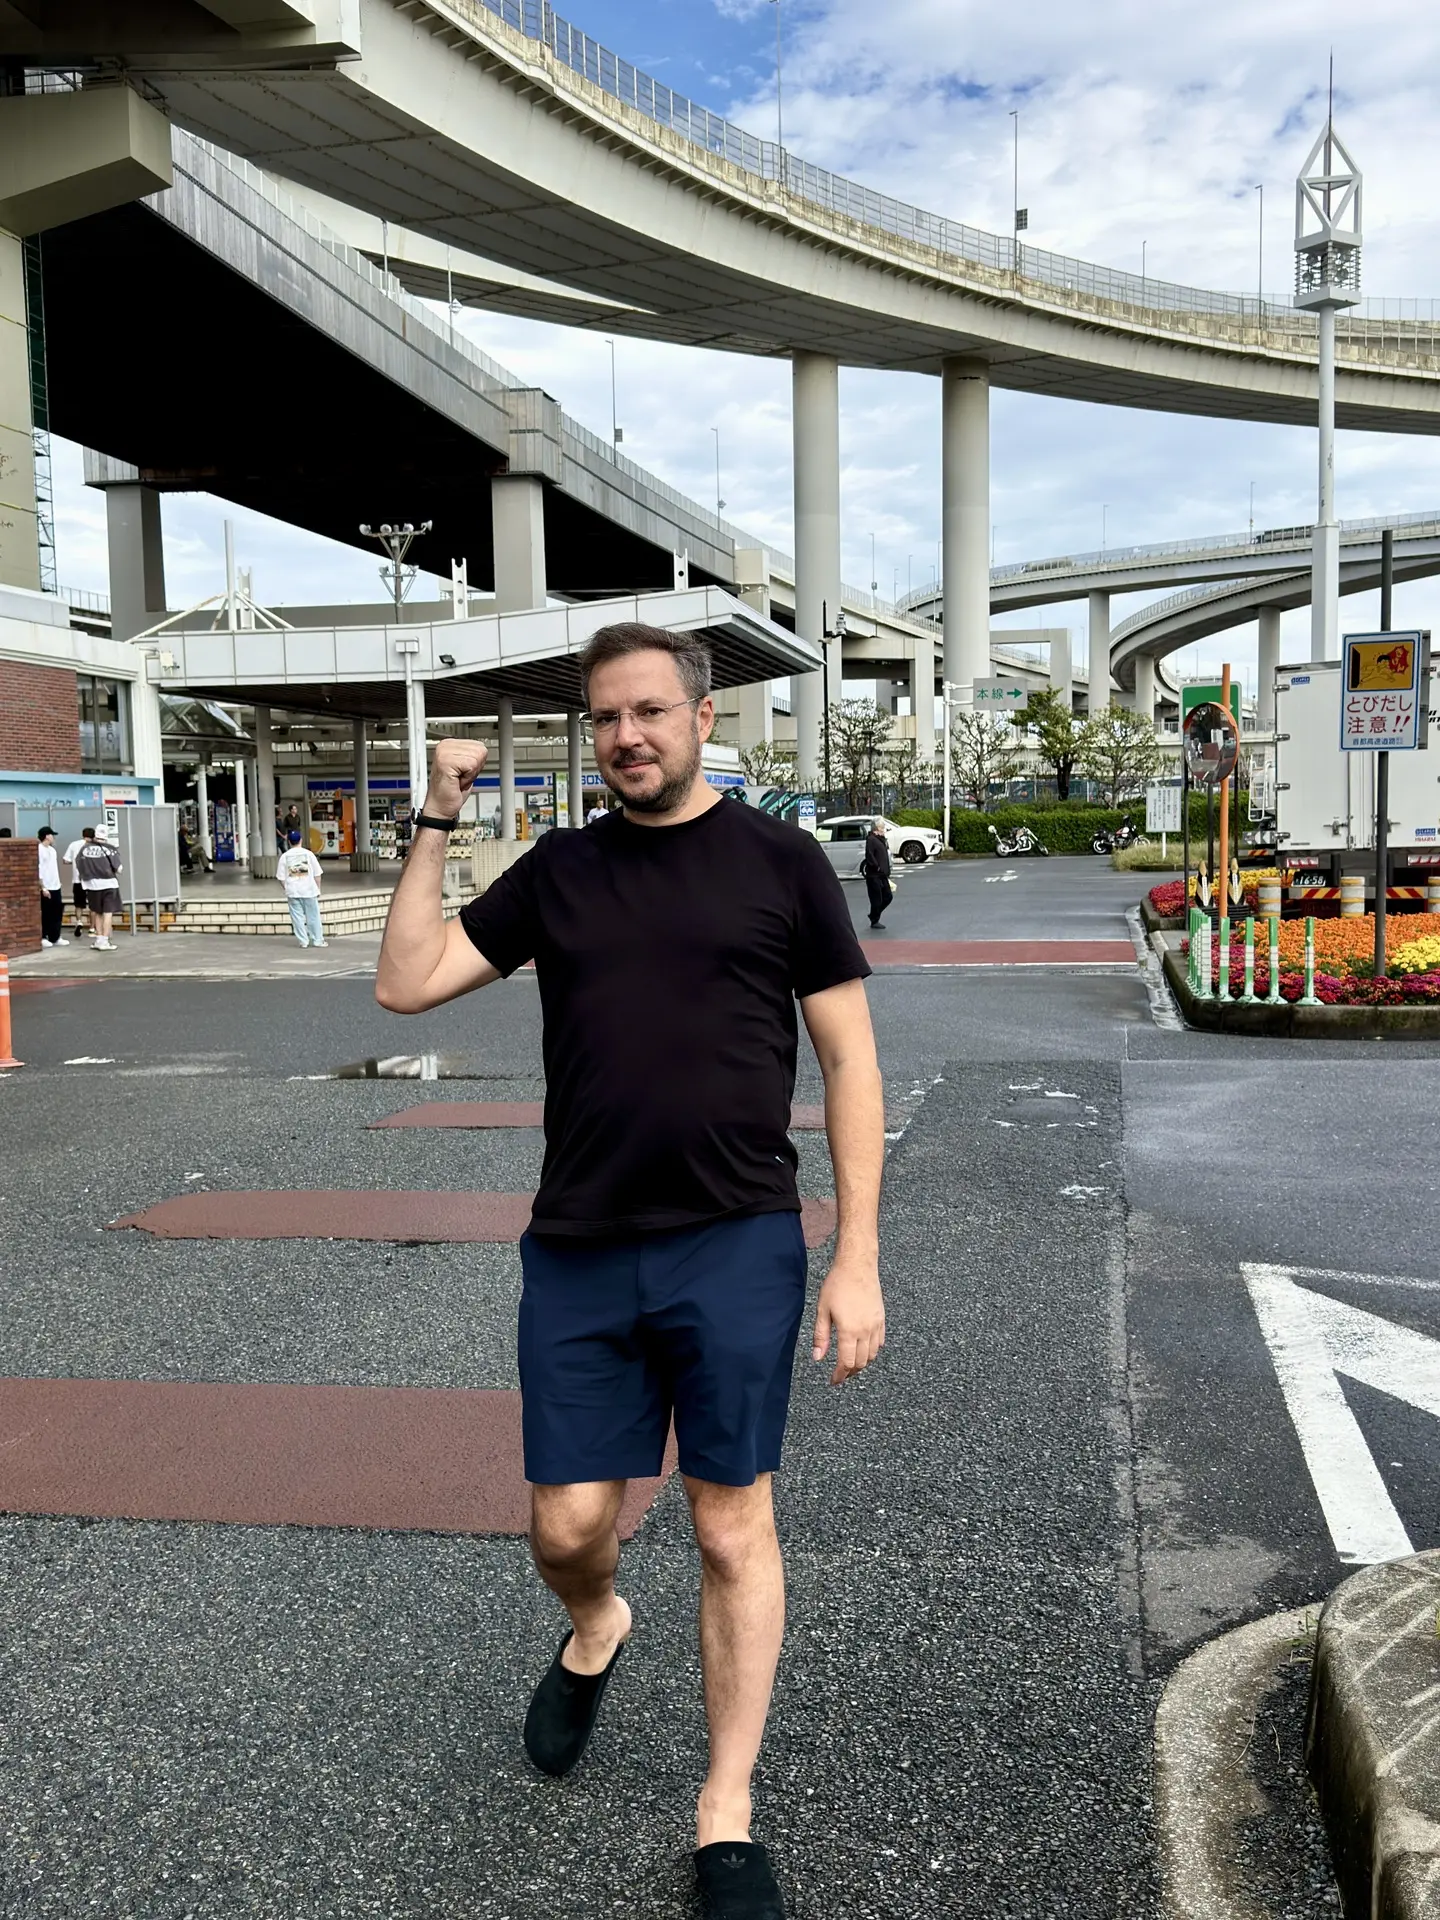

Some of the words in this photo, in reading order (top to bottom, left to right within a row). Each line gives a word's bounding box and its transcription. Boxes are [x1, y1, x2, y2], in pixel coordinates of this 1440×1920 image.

[976, 687, 1004, 700] 本線
[1346, 695, 1412, 713] とびだし
[547, 774, 607, 786] LSON
